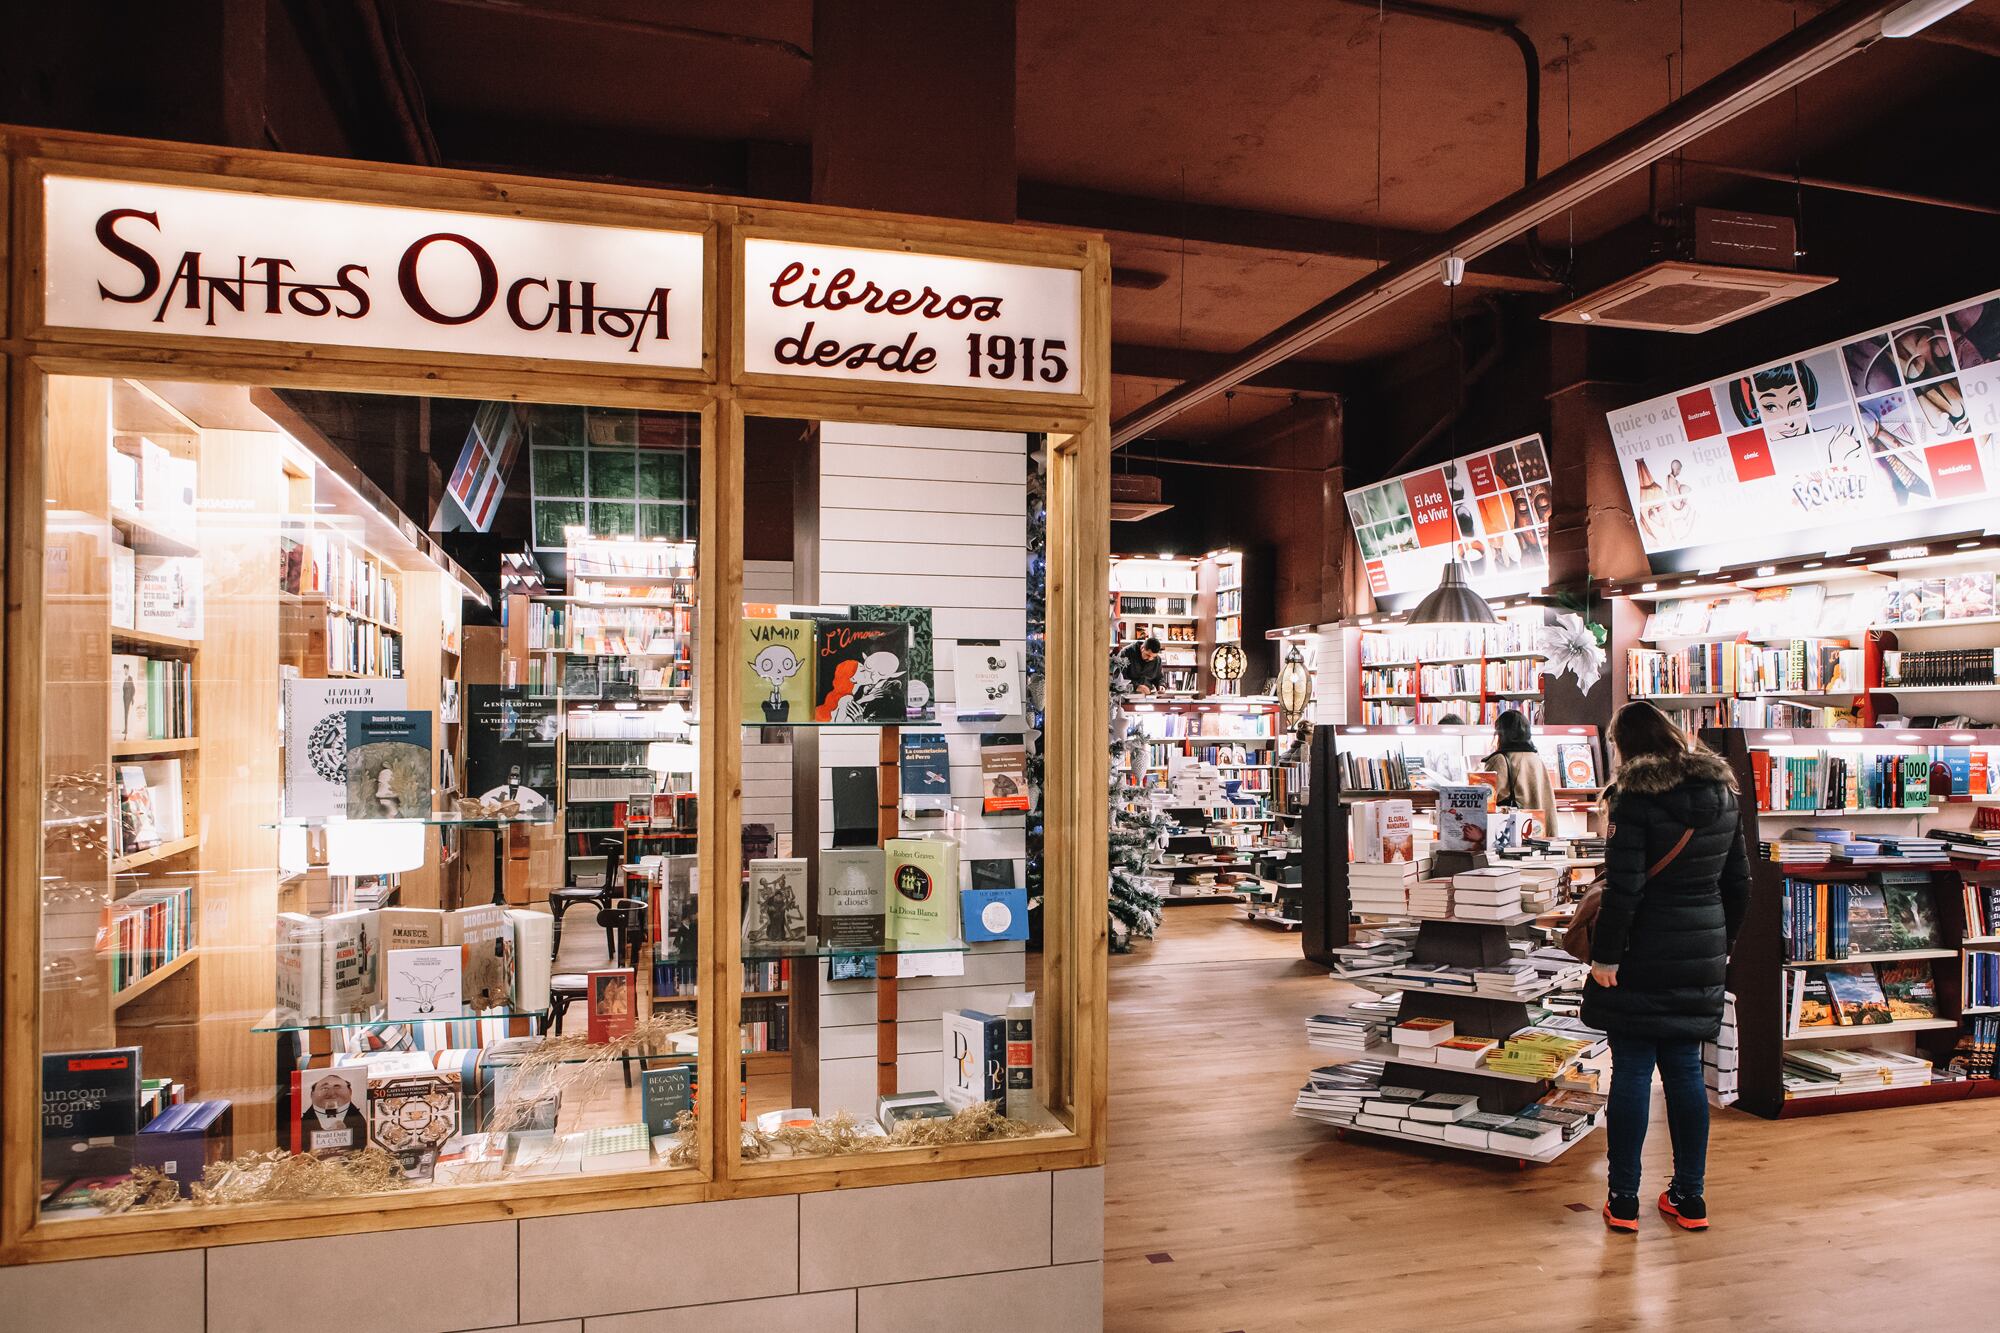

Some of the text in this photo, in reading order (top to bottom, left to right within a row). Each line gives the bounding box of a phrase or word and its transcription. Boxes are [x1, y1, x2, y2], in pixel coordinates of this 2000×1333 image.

[770, 262, 1004, 322] libreros
[774, 321, 1069, 384] desde 1915
[1414, 492, 1443, 509] El Arte
[1417, 507, 1448, 525] de Vivir
[750, 625, 800, 642] VAMPIR
[1905, 761, 1928, 777] 1000
[1450, 800, 1482, 808] AZUL
[893, 850, 935, 860] Robert Graves
[828, 886, 878, 896] De animales
[844, 897, 869, 906] dioses
[889, 906, 938, 917] La Diosa Blanca
[649, 1073, 685, 1085] BEGOÑA
[43, 1088, 107, 1102] uncom
[373, 1090, 386, 1099] 50
[316, 1138, 326, 1146] LA
